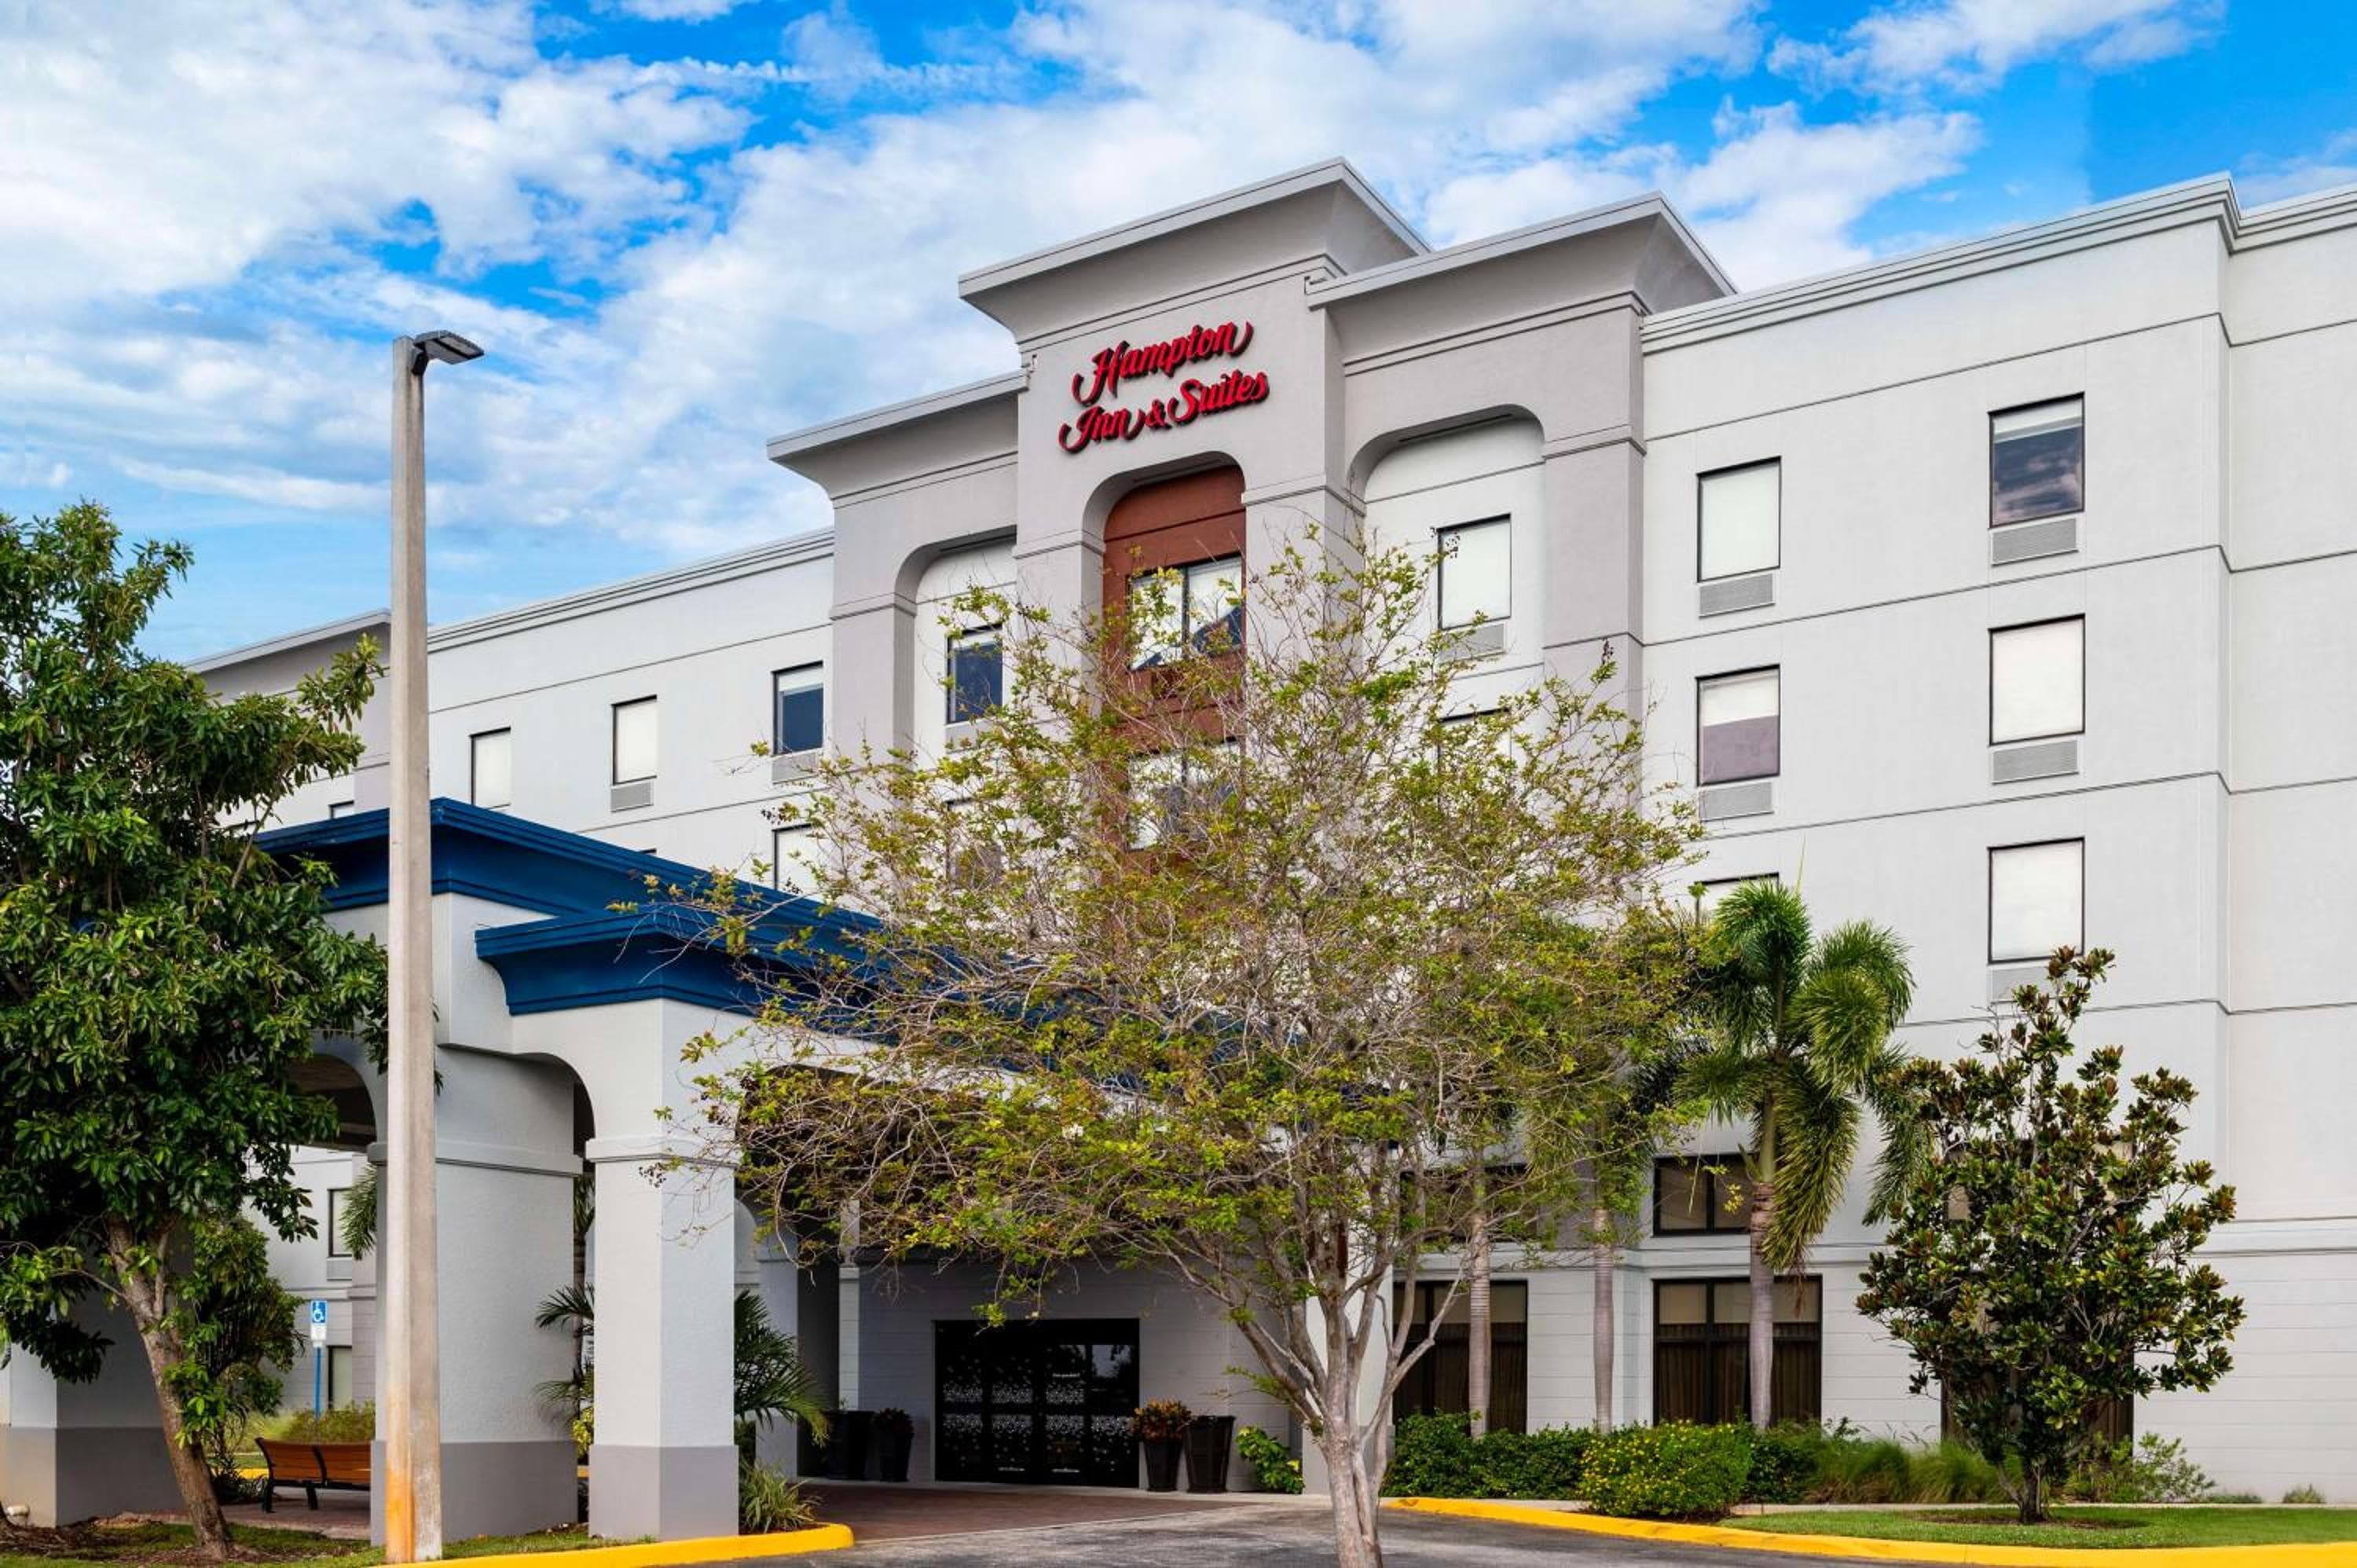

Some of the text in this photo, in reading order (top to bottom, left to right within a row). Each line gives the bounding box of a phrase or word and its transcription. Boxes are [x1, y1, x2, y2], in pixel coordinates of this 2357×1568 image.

[1072, 321, 1254, 406] Hampton
[1058, 369, 1270, 454] Inn & Suites
